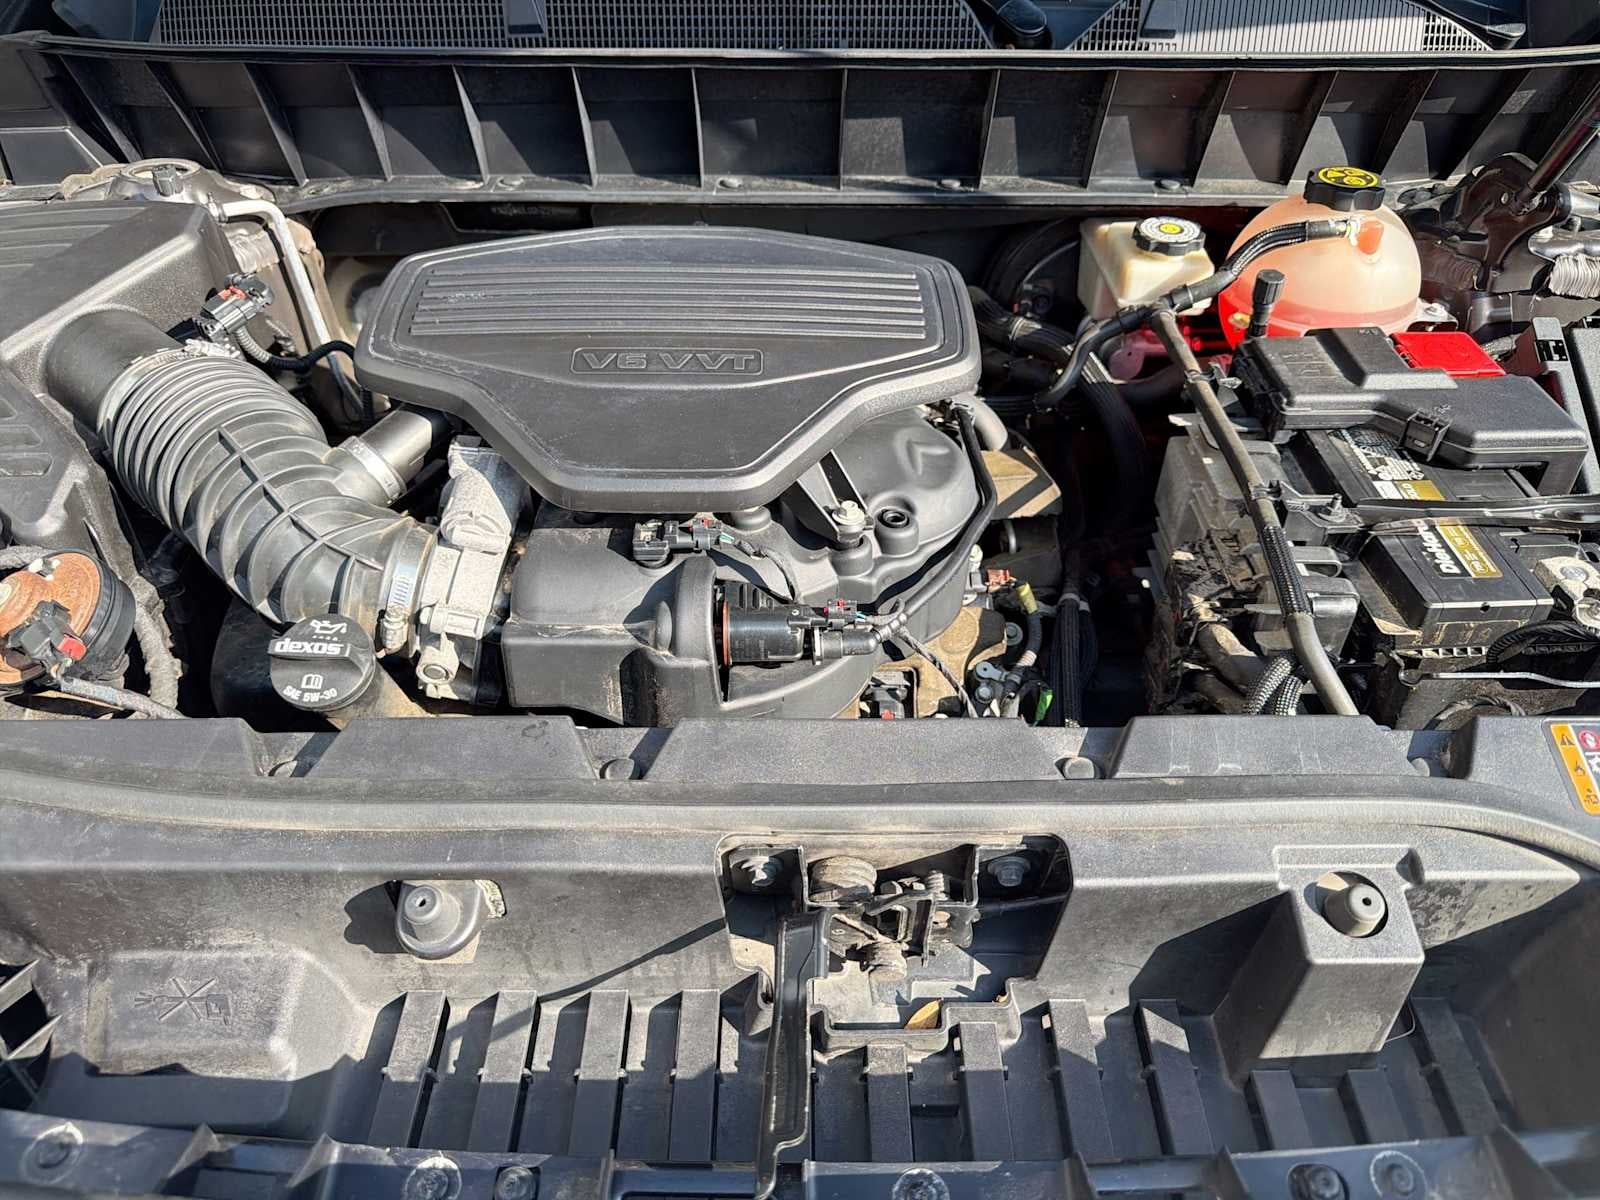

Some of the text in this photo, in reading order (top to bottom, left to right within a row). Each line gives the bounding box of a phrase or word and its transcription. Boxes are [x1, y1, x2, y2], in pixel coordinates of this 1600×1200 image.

[582, 352, 755, 371] V6 VVT
[274, 638, 344, 655] dexos
[283, 685, 338, 703] SAE 5W-30
